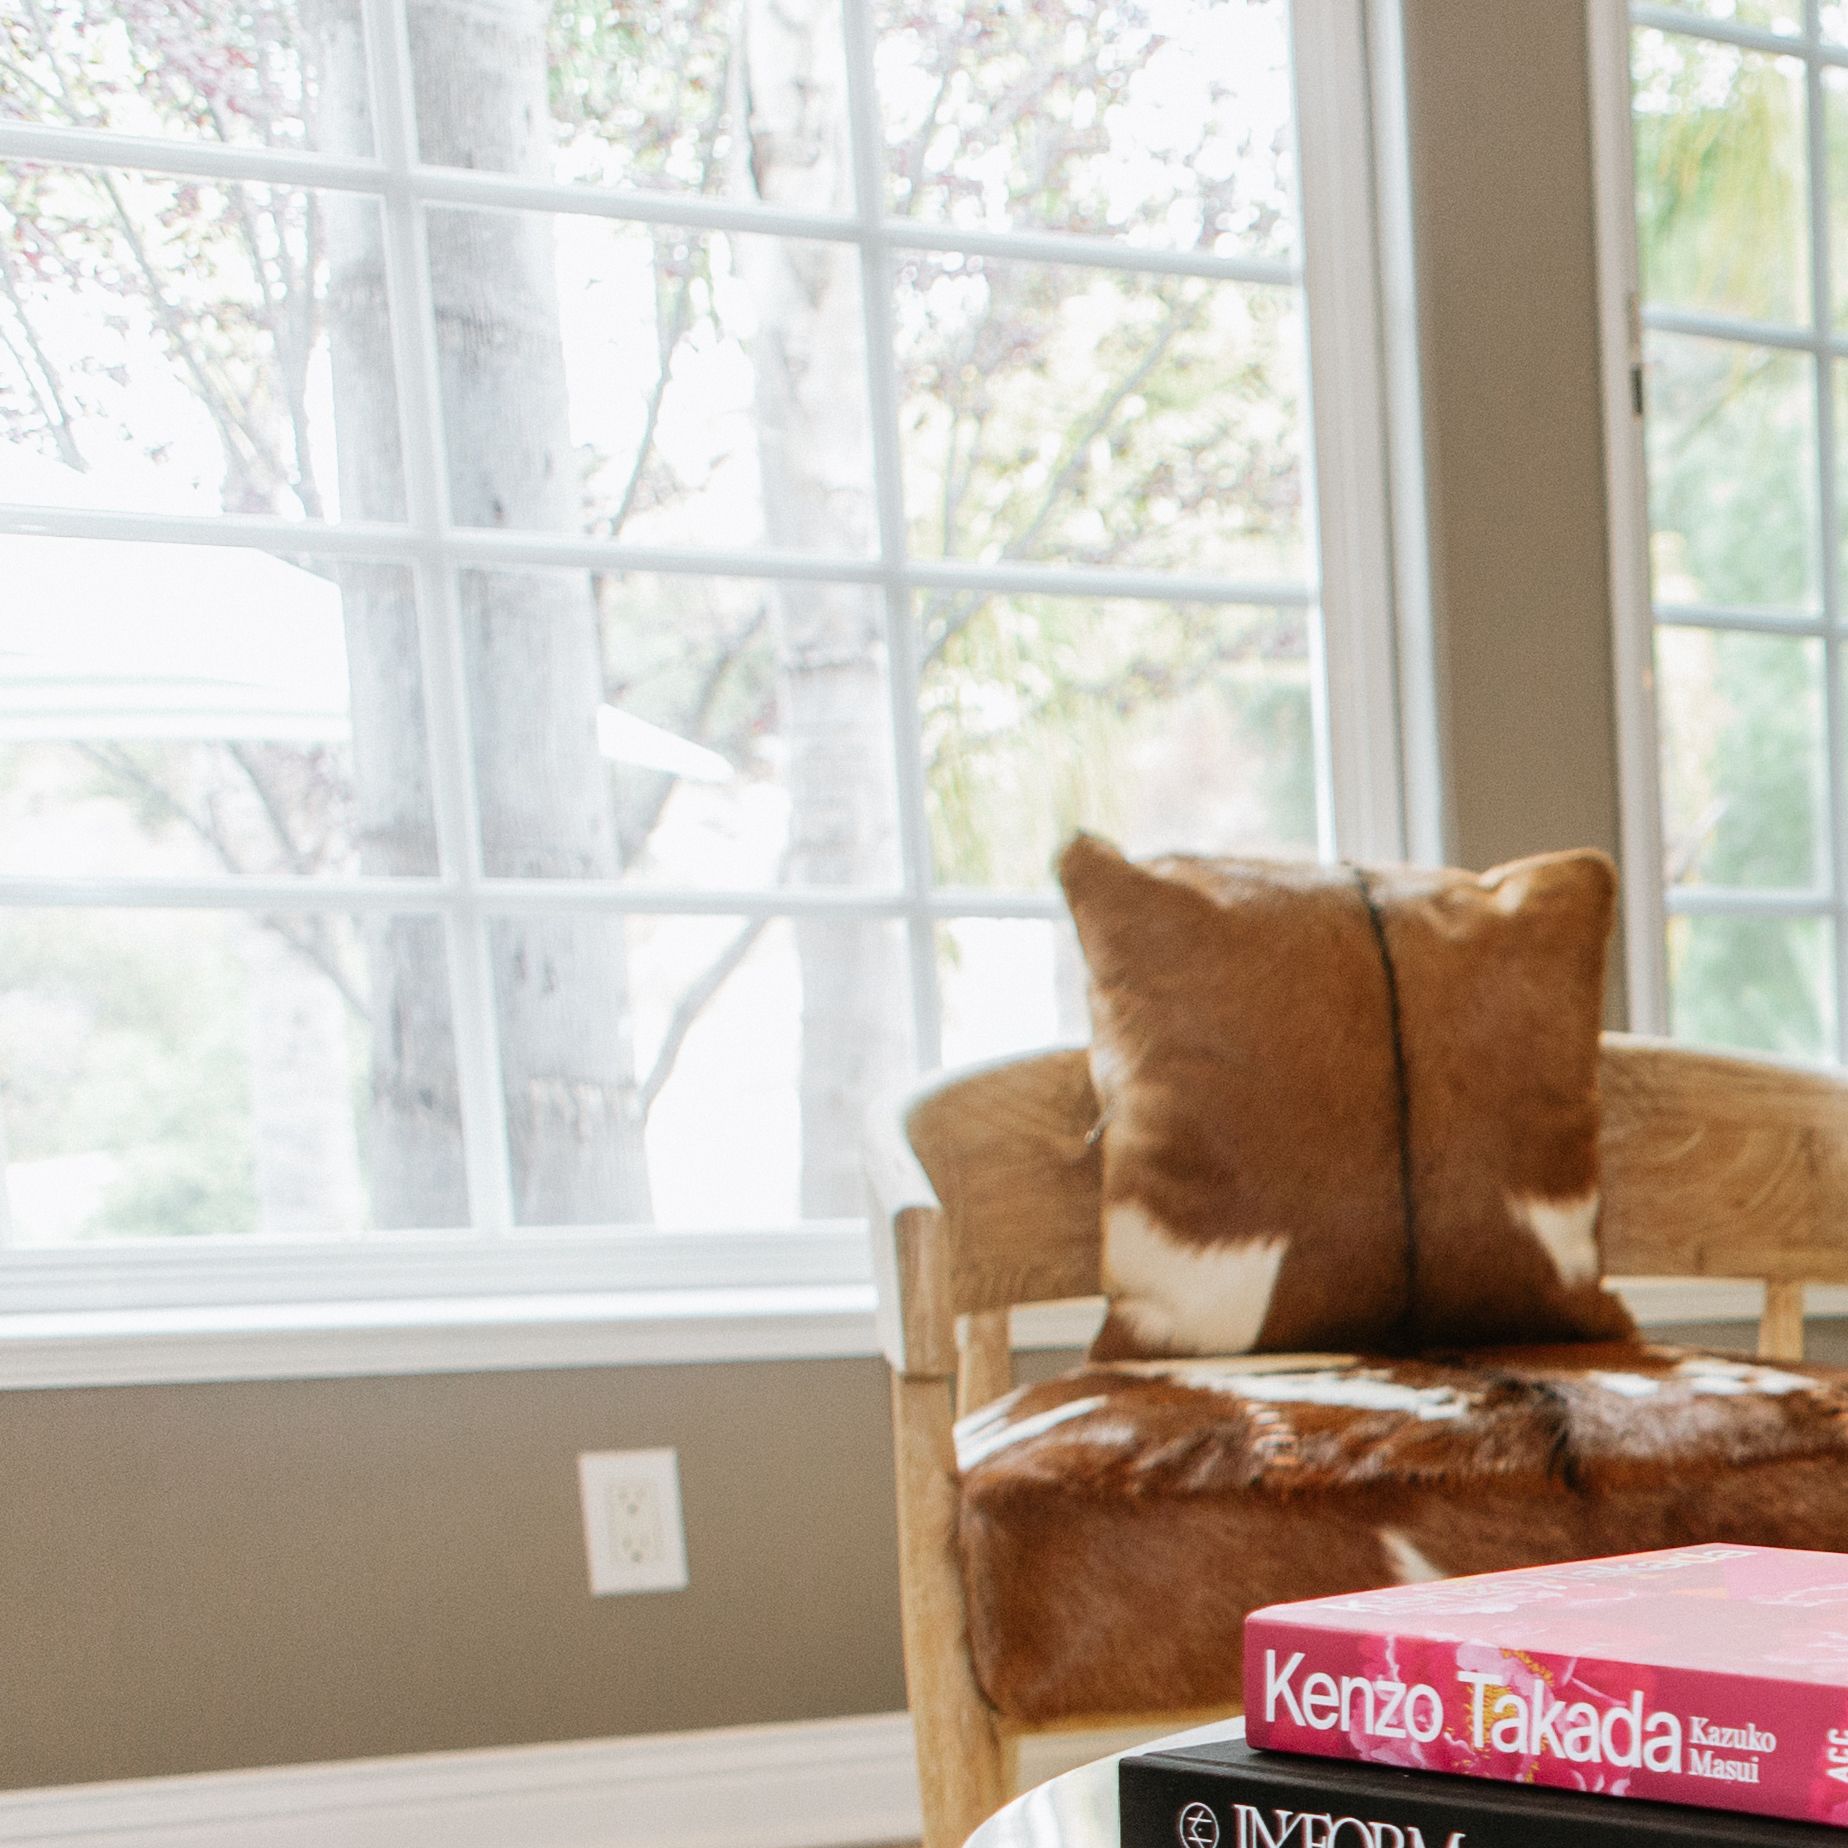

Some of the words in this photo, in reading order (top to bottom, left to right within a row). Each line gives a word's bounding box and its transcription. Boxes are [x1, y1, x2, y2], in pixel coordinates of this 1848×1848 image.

[1264, 1648, 1444, 1743] Kenzo
[1457, 1670, 1682, 1774] Takada
[1690, 1715, 1777, 1753] Kazuko
[1688, 1747, 1760, 1783] Masui
